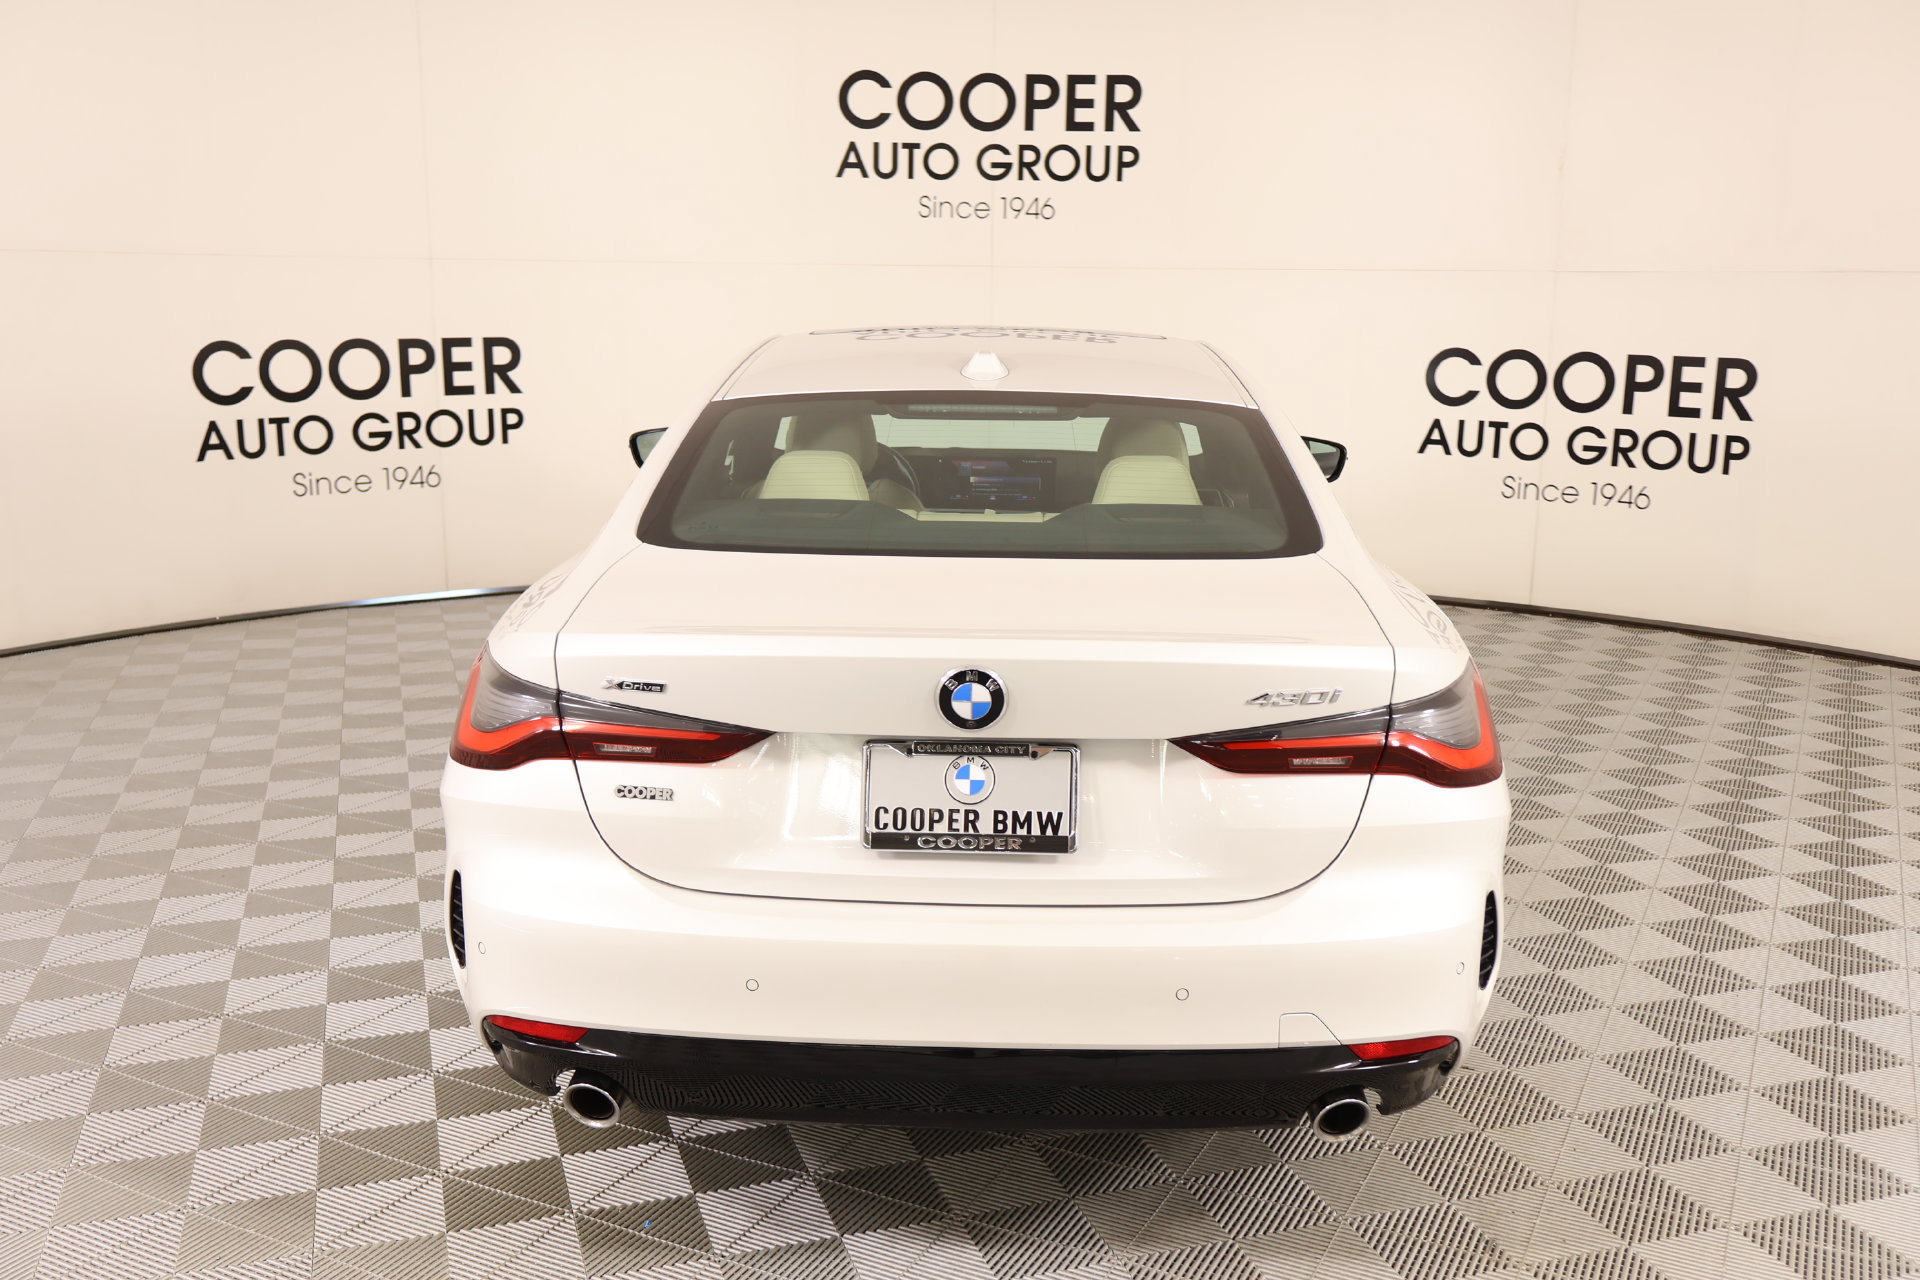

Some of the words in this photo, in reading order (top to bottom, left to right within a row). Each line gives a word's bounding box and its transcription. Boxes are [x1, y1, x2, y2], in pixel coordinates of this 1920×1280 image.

[838, 69, 1143, 133] COOPER
[835, 140, 960, 181] AUTO
[975, 143, 1140, 183] GROUP
[918, 195, 990, 220] Since
[1001, 196, 1055, 221] 1946
[191, 336, 523, 407] COOPER
[1425, 346, 1759, 422] COOPER
[195, 414, 335, 463] AUTO
[351, 407, 525, 453] GROUP
[1417, 418, 1550, 462] AUTO
[1566, 425, 1751, 476] GROUP
[292, 472, 372, 498] Since
[383, 464, 441, 490] 1946
[1501, 475, 1580, 504] Since
[1590, 481, 1651, 510] 1946
[944, 670, 1000, 692] BMW
[1245, 688, 1343, 707] 430i
[917, 743, 992, 754] OKLAHOMA
[995, 745, 1026, 755] CITY
[952, 756, 989, 770] BMW
[614, 784, 674, 801] COOPER
[874, 806, 980, 834] COOPER
[992, 809, 1064, 836] BMW
[917, 835, 1023, 850] COOPER
